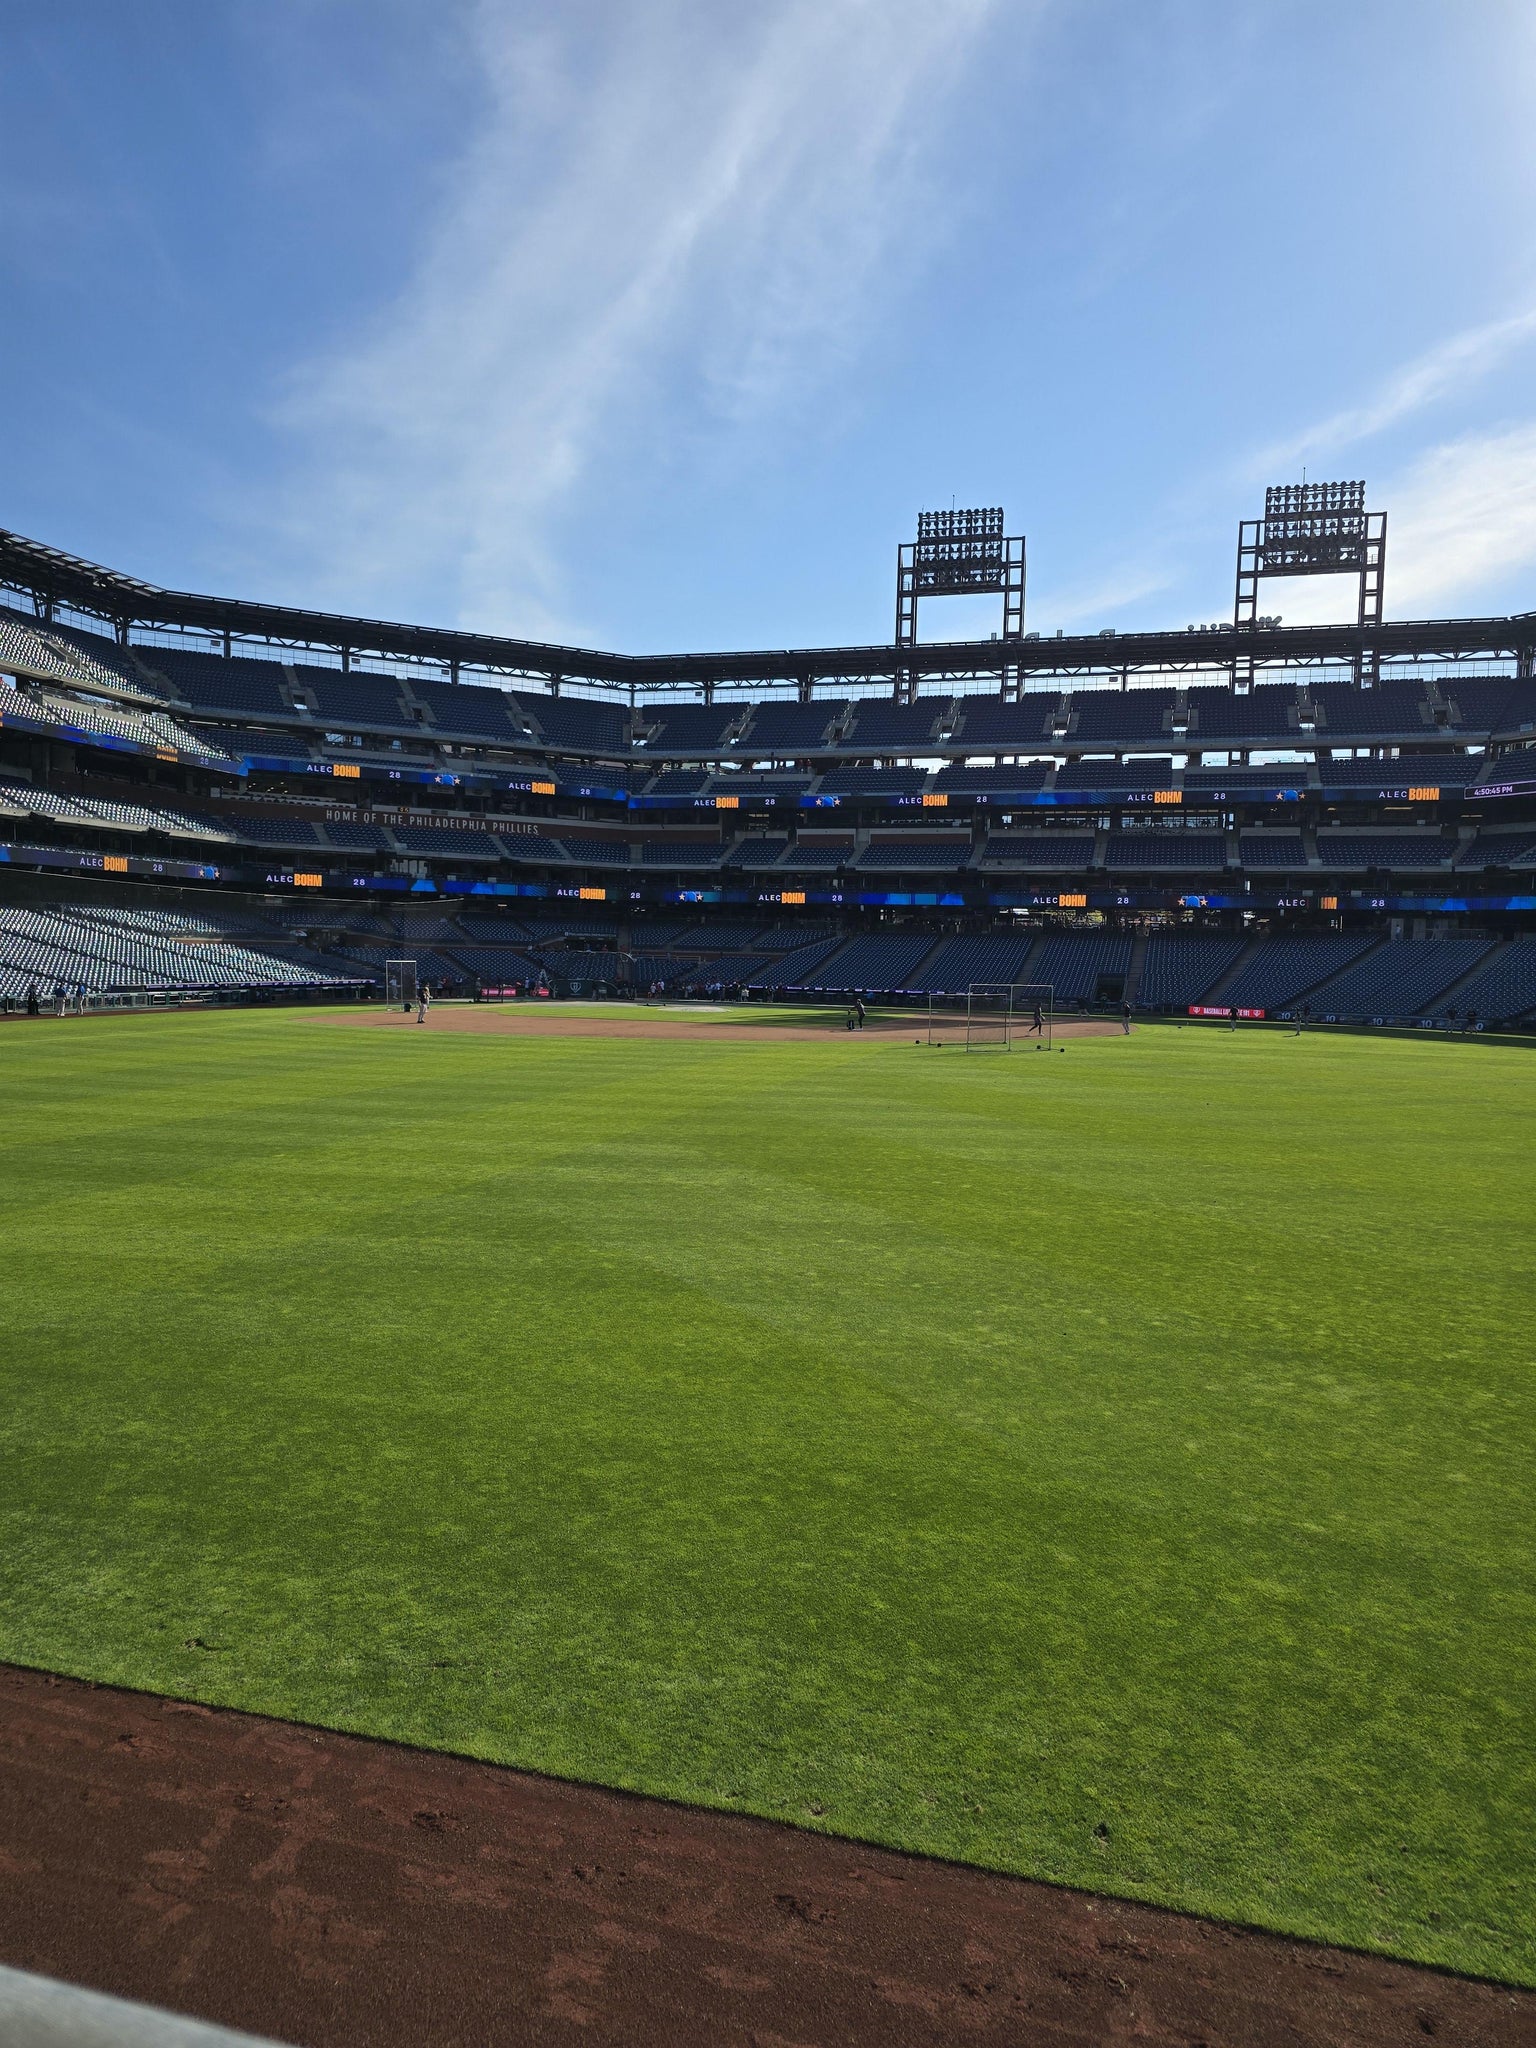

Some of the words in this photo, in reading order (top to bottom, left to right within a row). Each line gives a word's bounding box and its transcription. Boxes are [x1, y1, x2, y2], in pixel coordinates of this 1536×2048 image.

[306, 764, 332, 773] ALEC
[333, 764, 360, 778] BOHM
[389, 771, 400, 779] 28
[508, 782, 531, 790] ALEC
[531, 782, 555, 795] BOHM
[1379, 790, 1408, 798] ALEC
[1408, 788, 1440, 801] BOHM
[1474, 786, 1500, 796] 4:50:45
[1502, 785, 1513, 793] PM
[716, 797, 739, 809] BOHM
[923, 795, 948, 806] BOHM
[976, 795, 987, 803] 28
[1154, 791, 1182, 803] BOHM
[1214, 792, 1226, 800] 28
[326, 809, 357, 822] HOME
[363, 812, 377, 823] OF
[383, 813, 403, 825] THE
[409, 816, 487, 831] PHILADELPHIA
[492, 821, 539, 835] PHILLIES
[80, 857, 103, 867] ALEC
[104, 856, 128, 872] BOHM
[152, 863, 163, 872] 28
[266, 874, 293, 883] ALEC
[294, 873, 322, 887] BOHM
[353, 878, 365, 886] 28
[580, 887, 606, 900] BOHM
[781, 892, 806, 904] BOHM
[1058, 894, 1087, 907] BOHM
[1277, 899, 1306, 907] ALEC
[1371, 899, 1385, 907] 28
